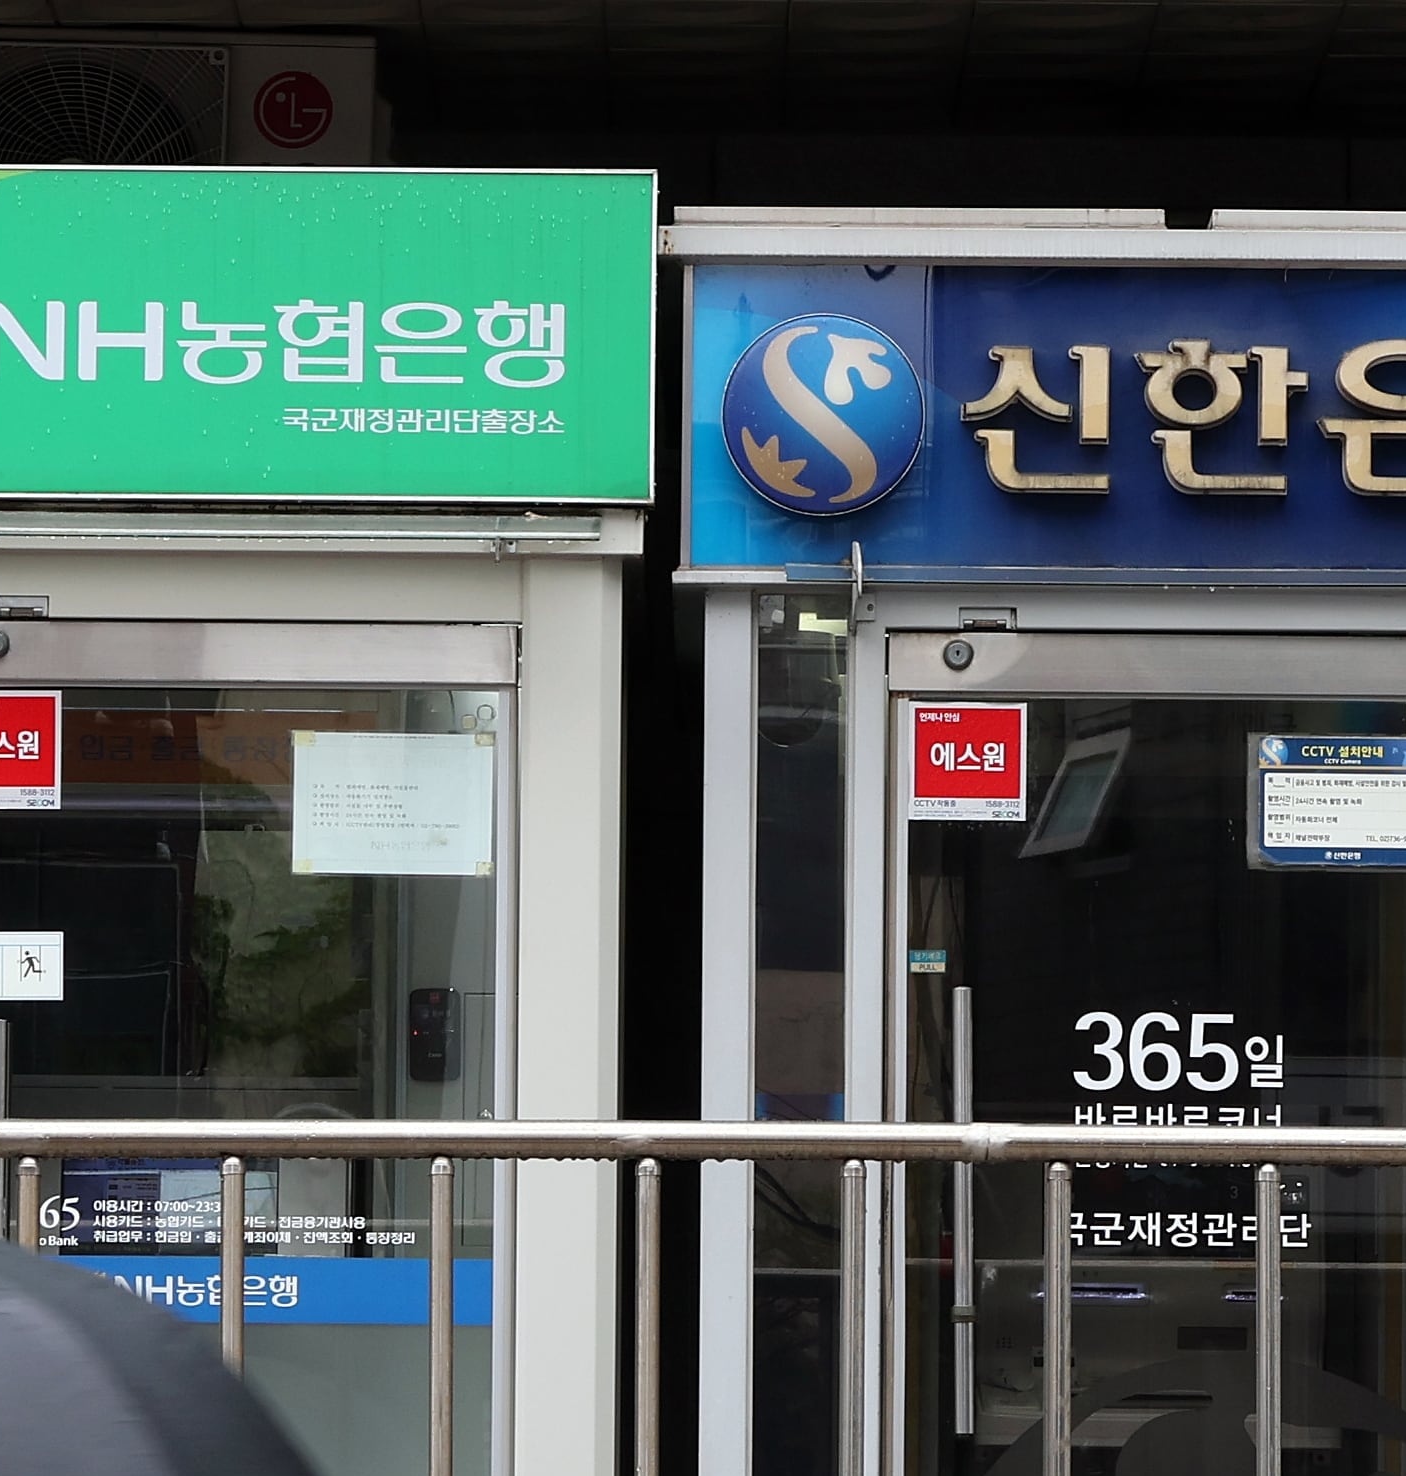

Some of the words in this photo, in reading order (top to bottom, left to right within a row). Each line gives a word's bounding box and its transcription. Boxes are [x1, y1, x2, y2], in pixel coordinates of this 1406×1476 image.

[281, 406, 567, 436] 국군재정관리단출장소
[930, 742, 1005, 771] 에스원
[1301, 746, 1334, 757] CCTV
[1339, 746, 1384, 758] 설치안내
[1073, 1011, 1284, 1091] 365일
[94, 1200, 143, 1212] 이용시간
[156, 1201, 221, 1213] 07:00~23:3
[49, 1235, 79, 1246] Bank
